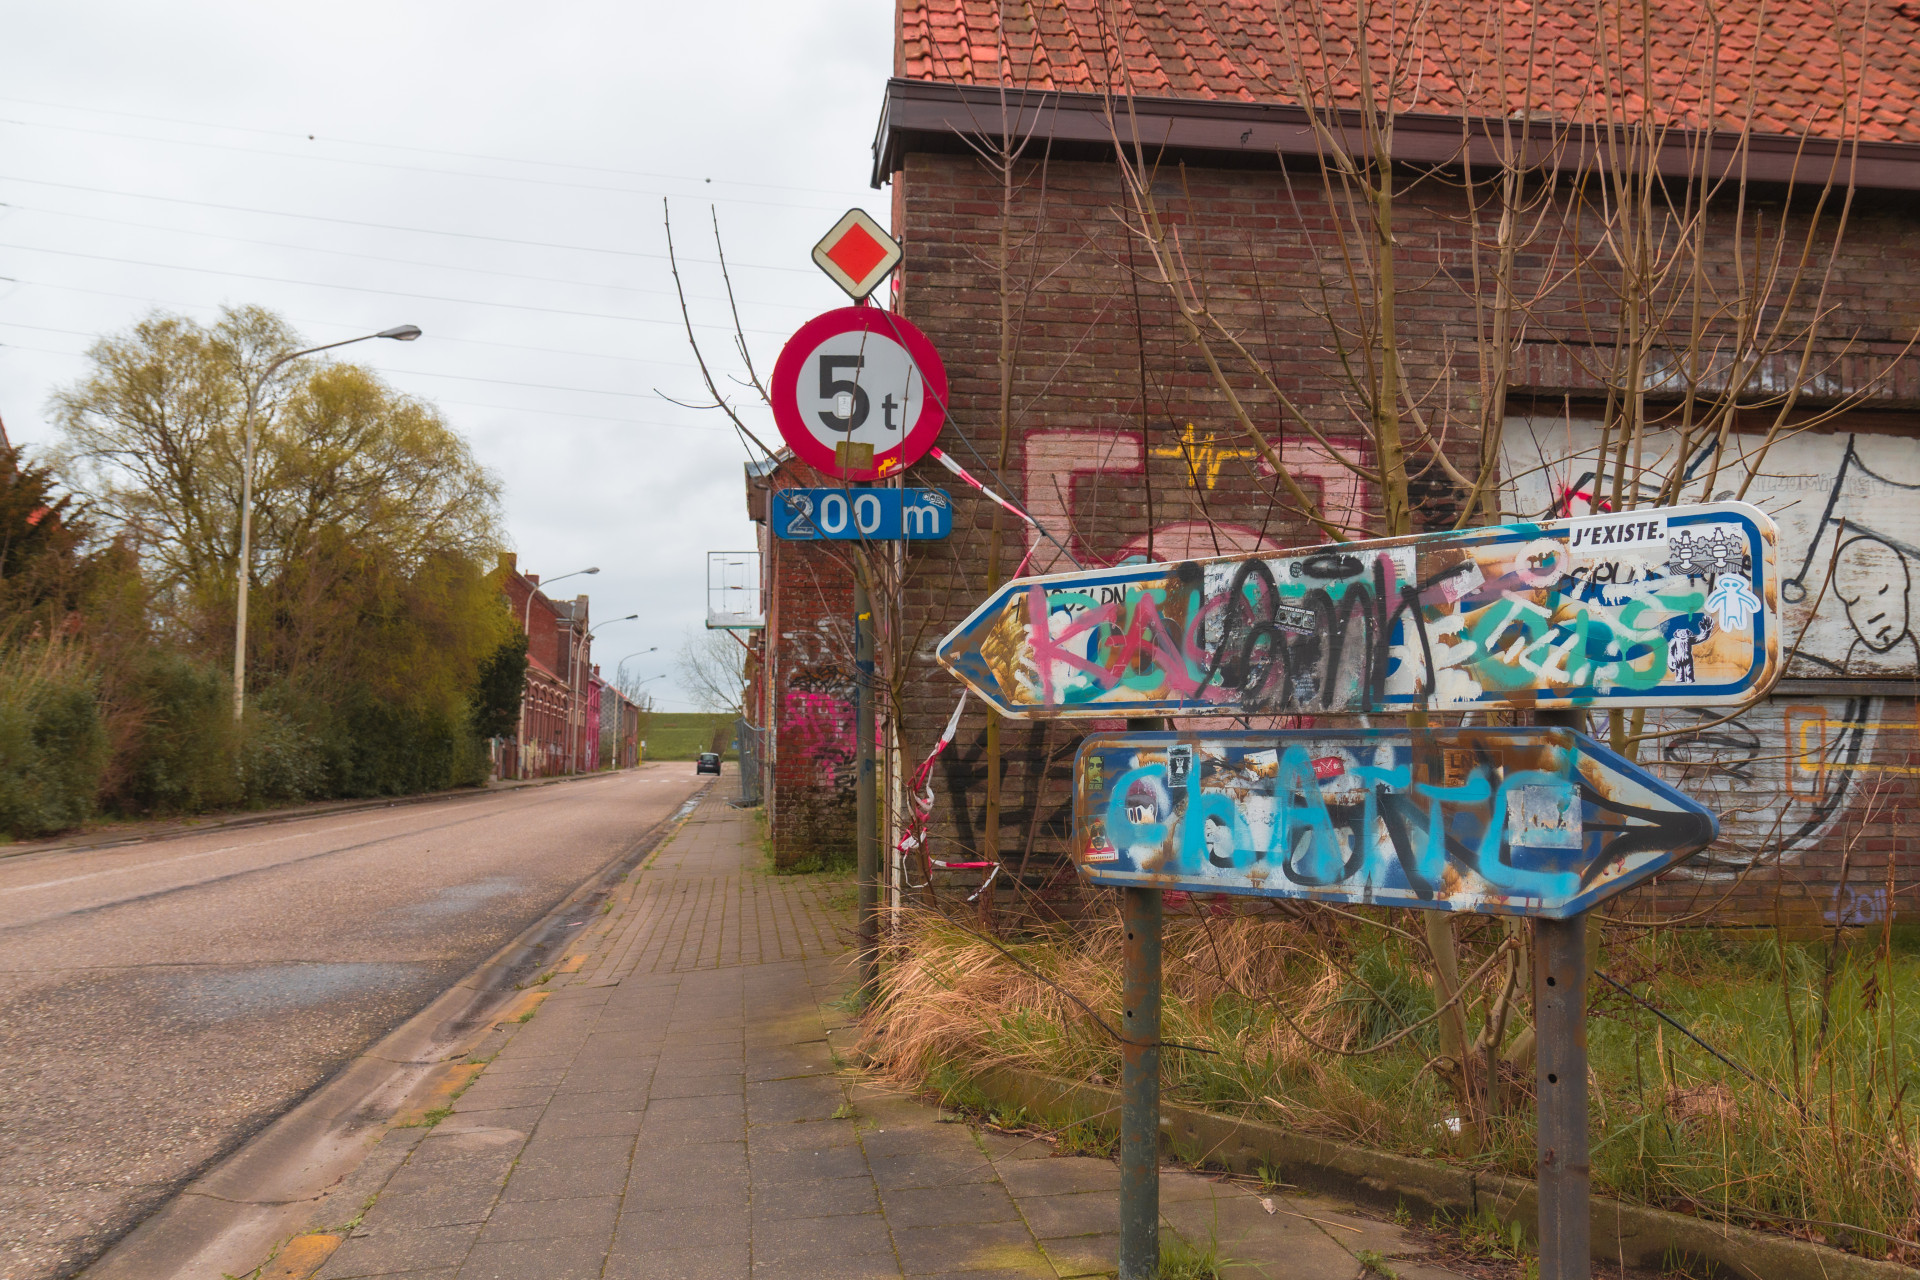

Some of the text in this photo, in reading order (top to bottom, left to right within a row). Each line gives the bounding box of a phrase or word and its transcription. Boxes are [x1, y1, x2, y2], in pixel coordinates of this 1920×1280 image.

[818, 354, 898, 433] 5 t
[787, 493, 940, 535] 200 m
[1572, 521, 1665, 547] J'EXISTE.
